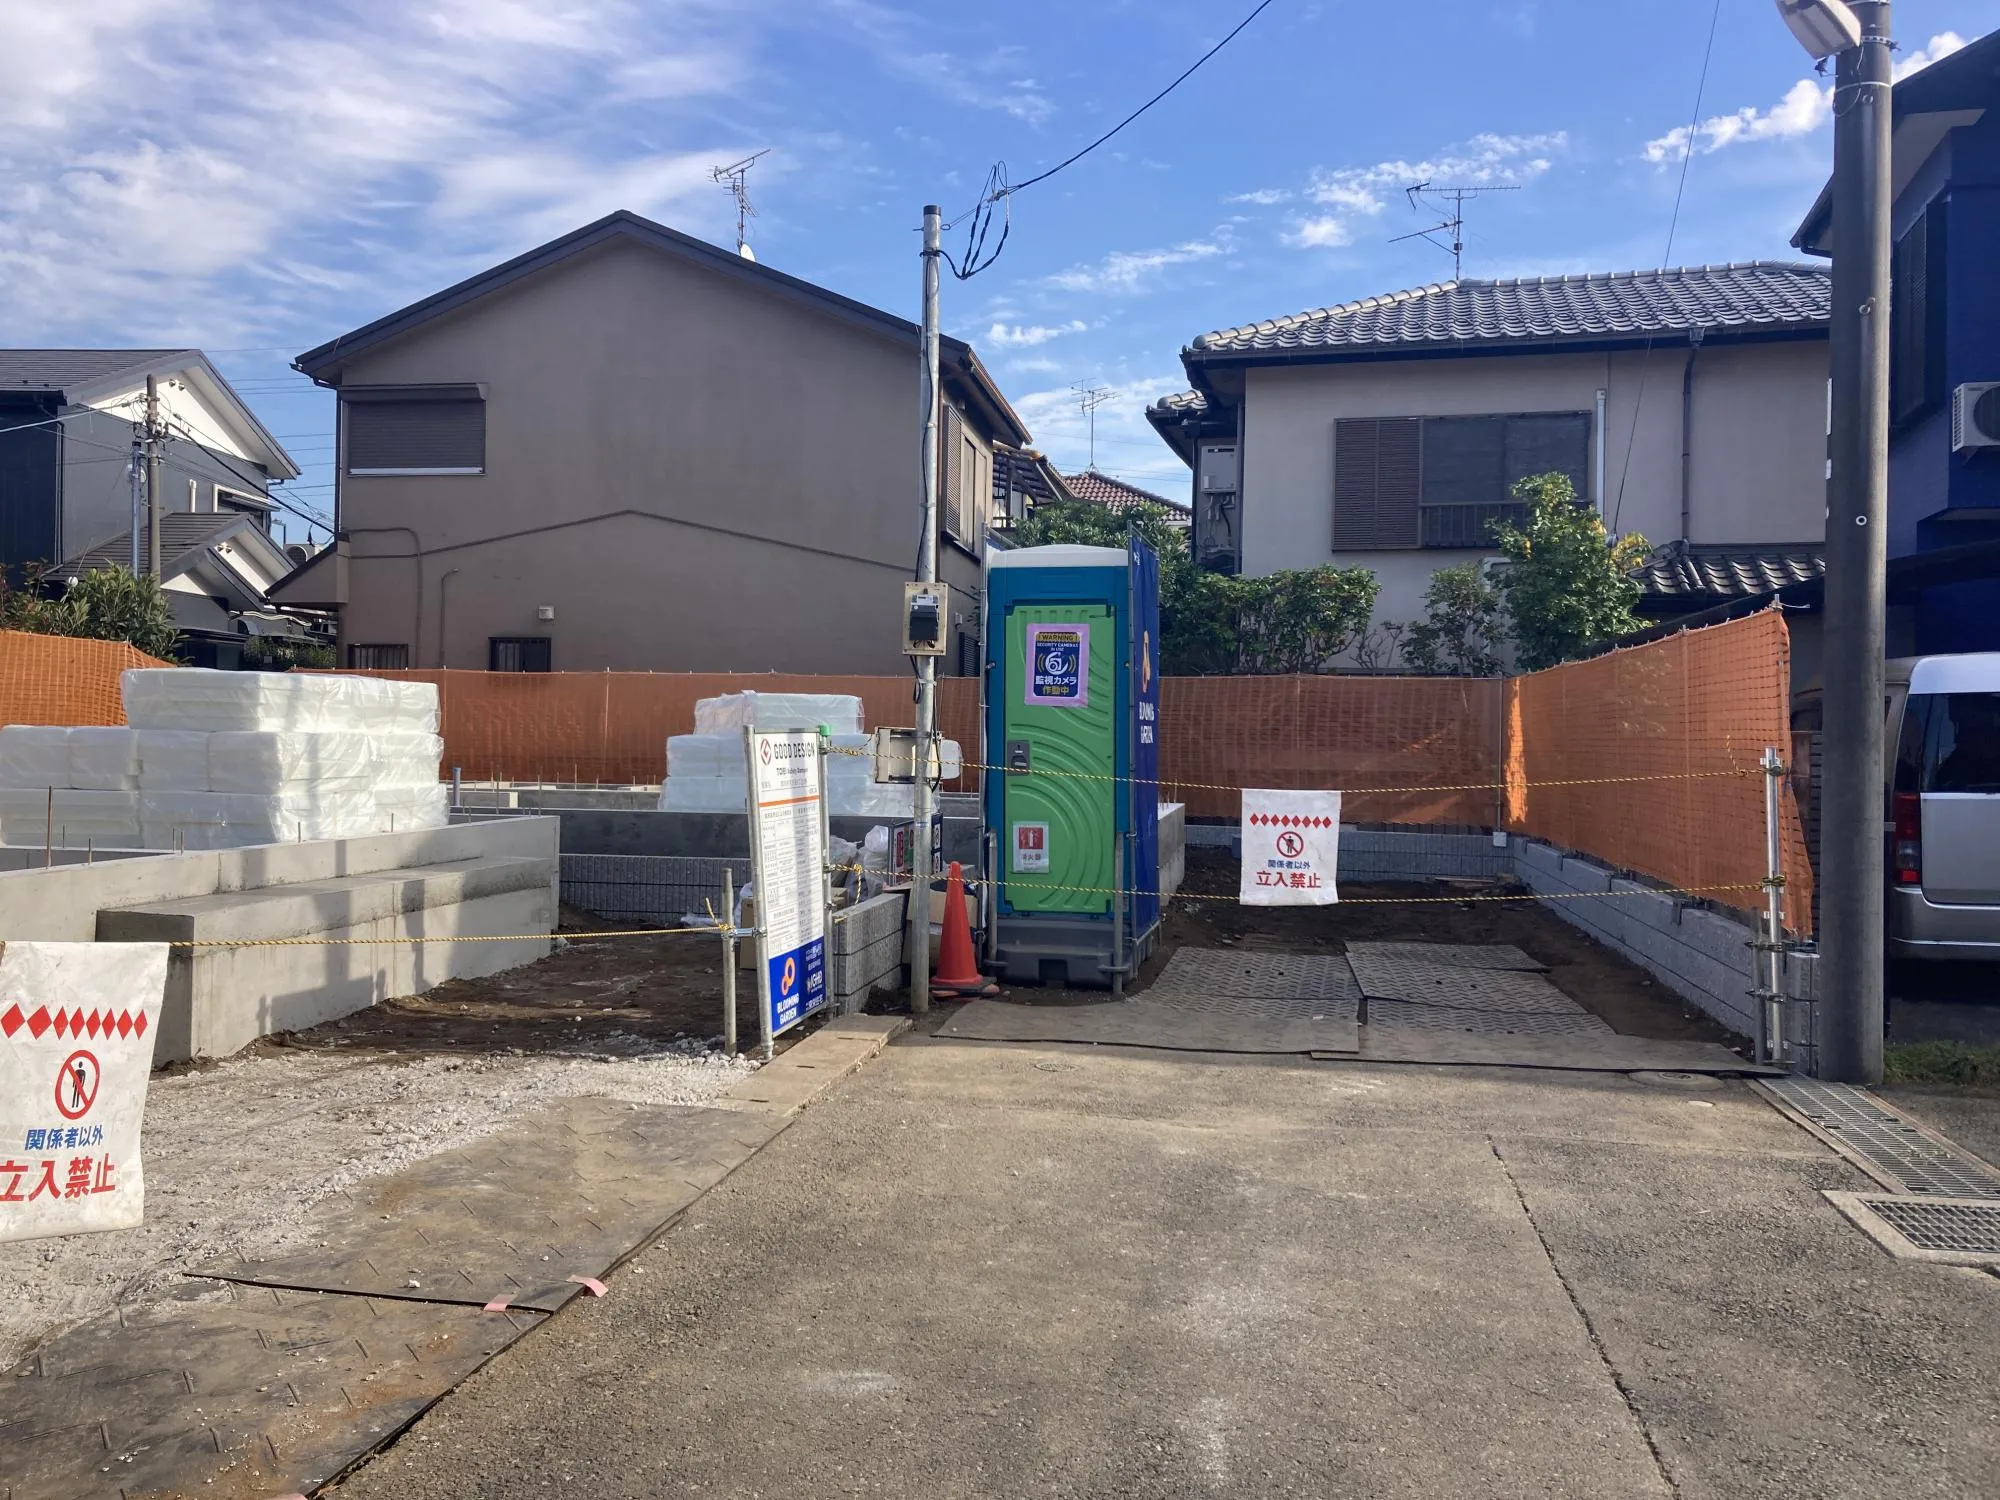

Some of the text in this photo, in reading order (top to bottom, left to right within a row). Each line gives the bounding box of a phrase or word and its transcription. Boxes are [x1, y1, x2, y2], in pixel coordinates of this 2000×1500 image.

[1035, 675, 1077, 685] 監視カメラ
[774, 742, 815, 760] GOOD DESIGN
[1267, 859, 1311, 869] 関係者以外
[1256, 870, 1321, 888] 立入禁止
[780, 1006, 797, 1025] GARDEN
[25, 1125, 104, 1150] 関係者以外
[0, 1153, 116, 1202] 立入禁止
